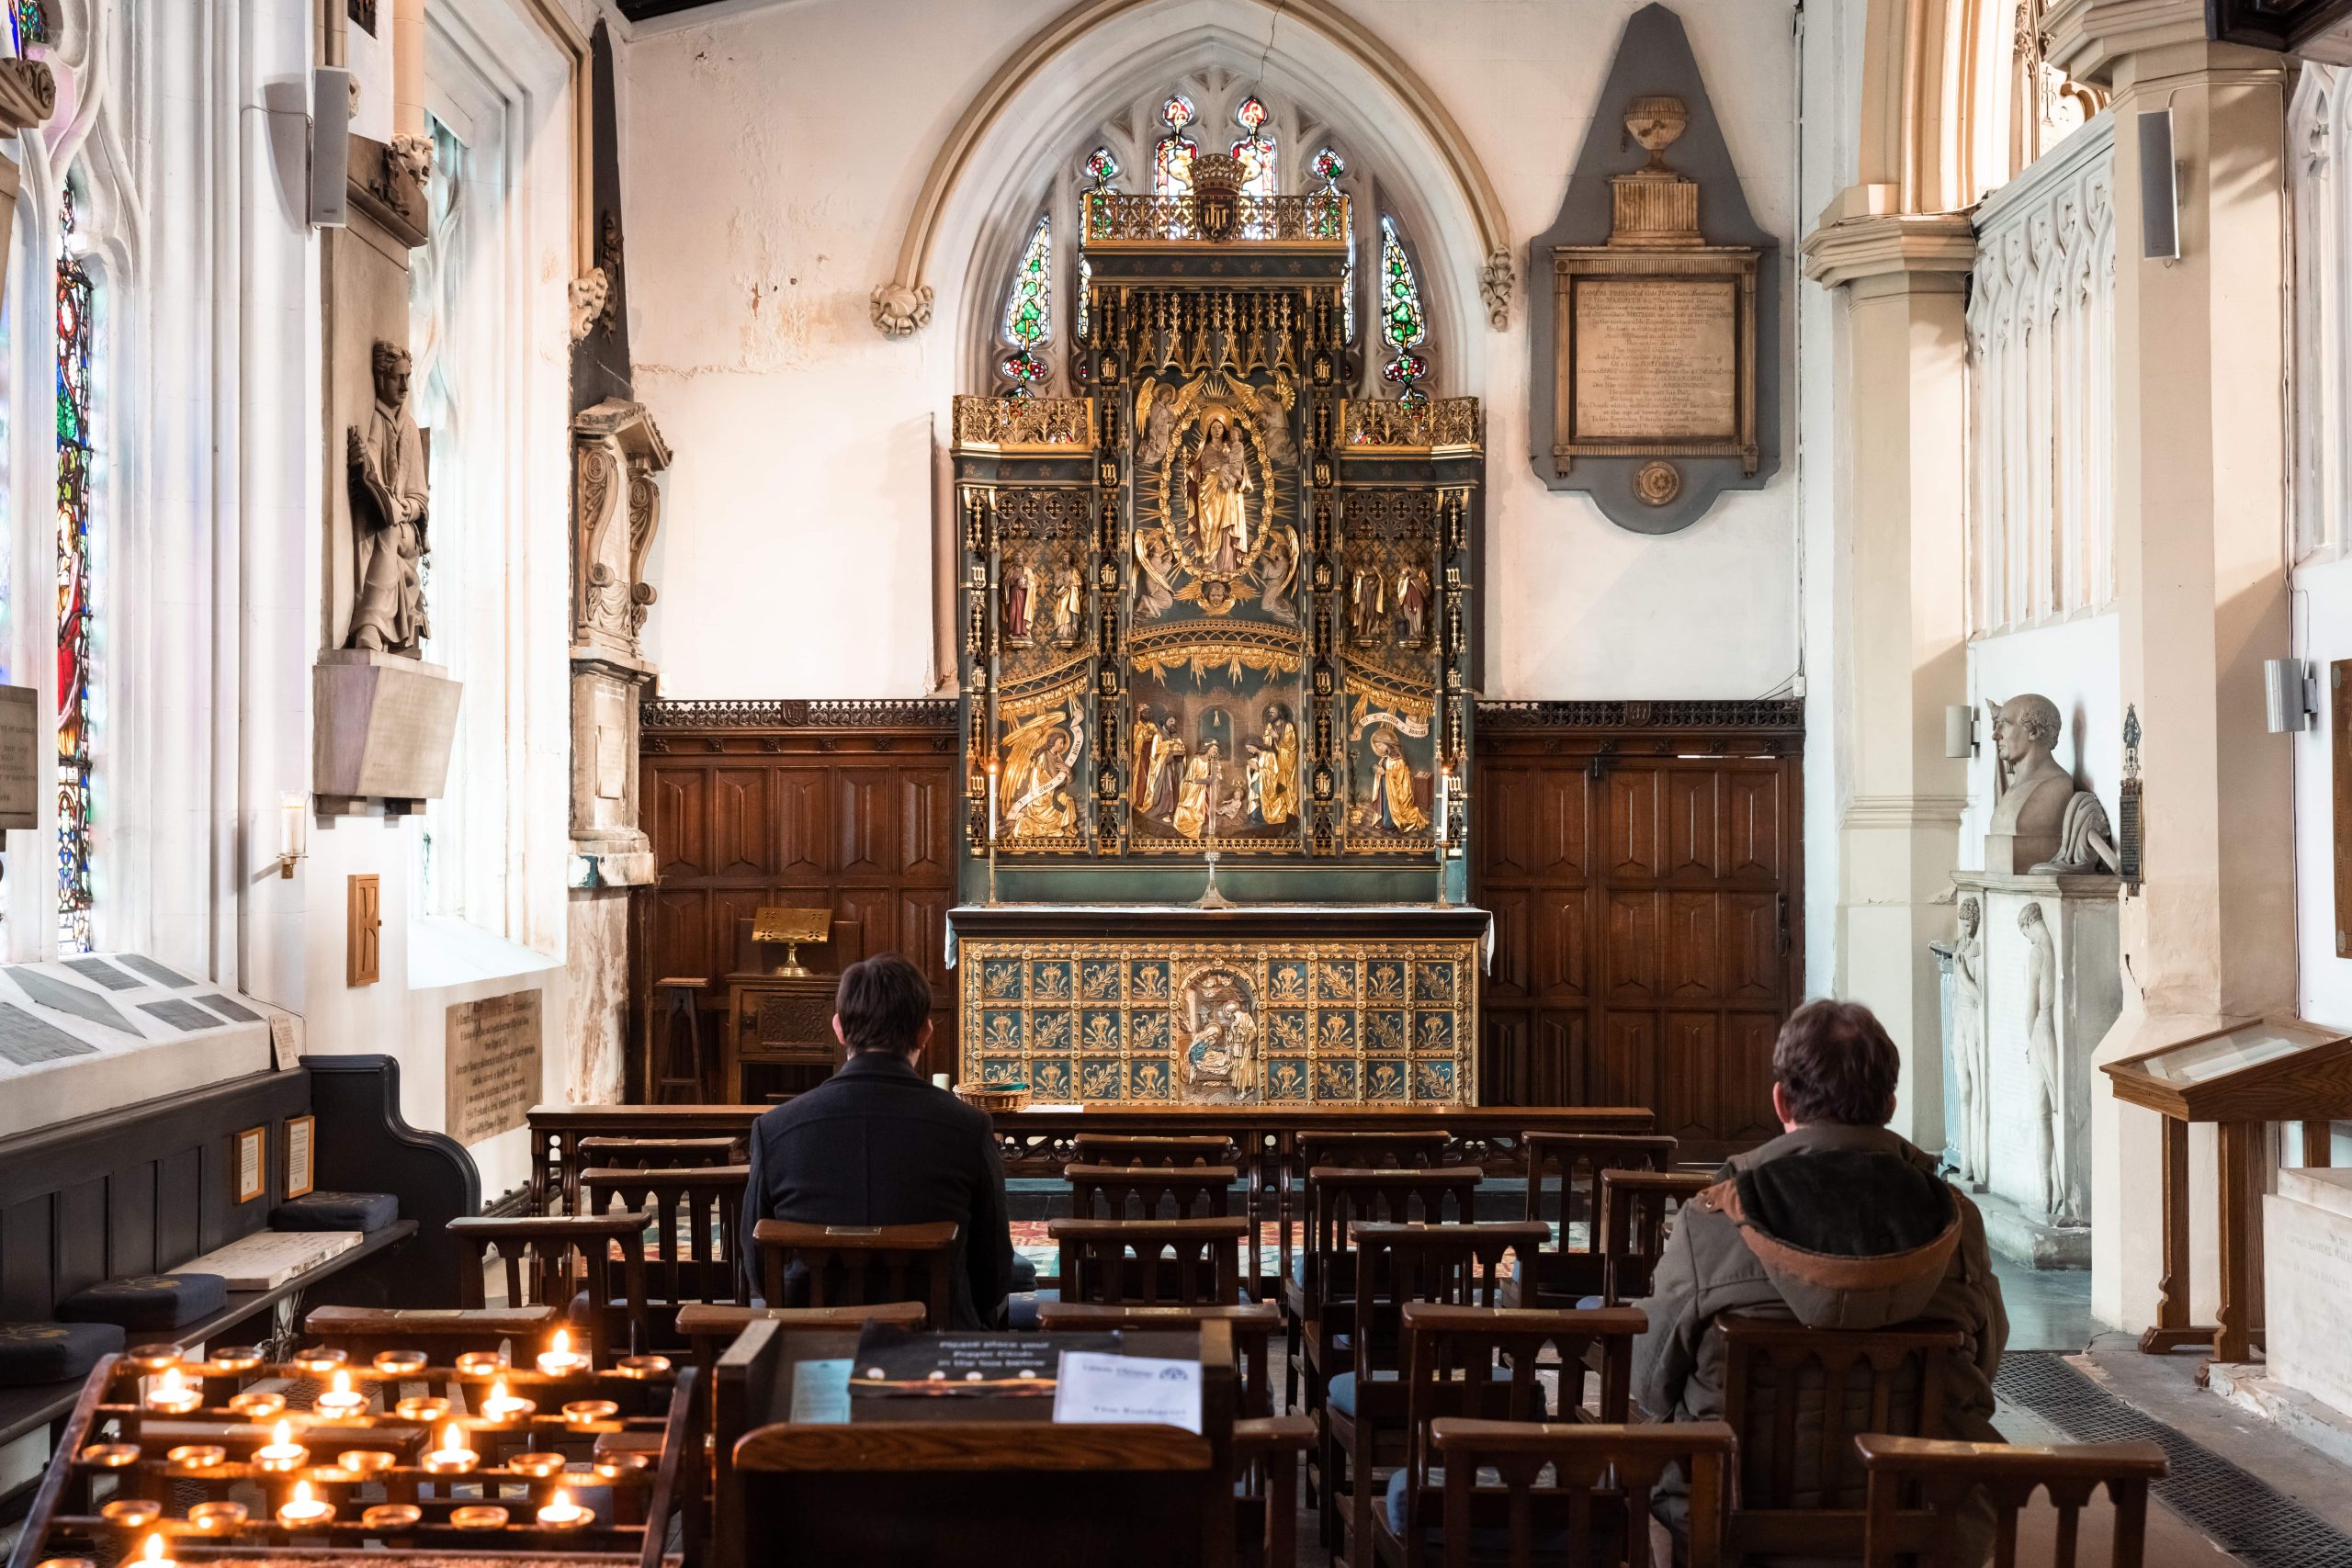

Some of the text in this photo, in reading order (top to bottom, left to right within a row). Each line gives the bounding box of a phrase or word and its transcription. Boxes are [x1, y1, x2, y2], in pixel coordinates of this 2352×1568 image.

[939, 1340, 1050, 1349] Please place your
